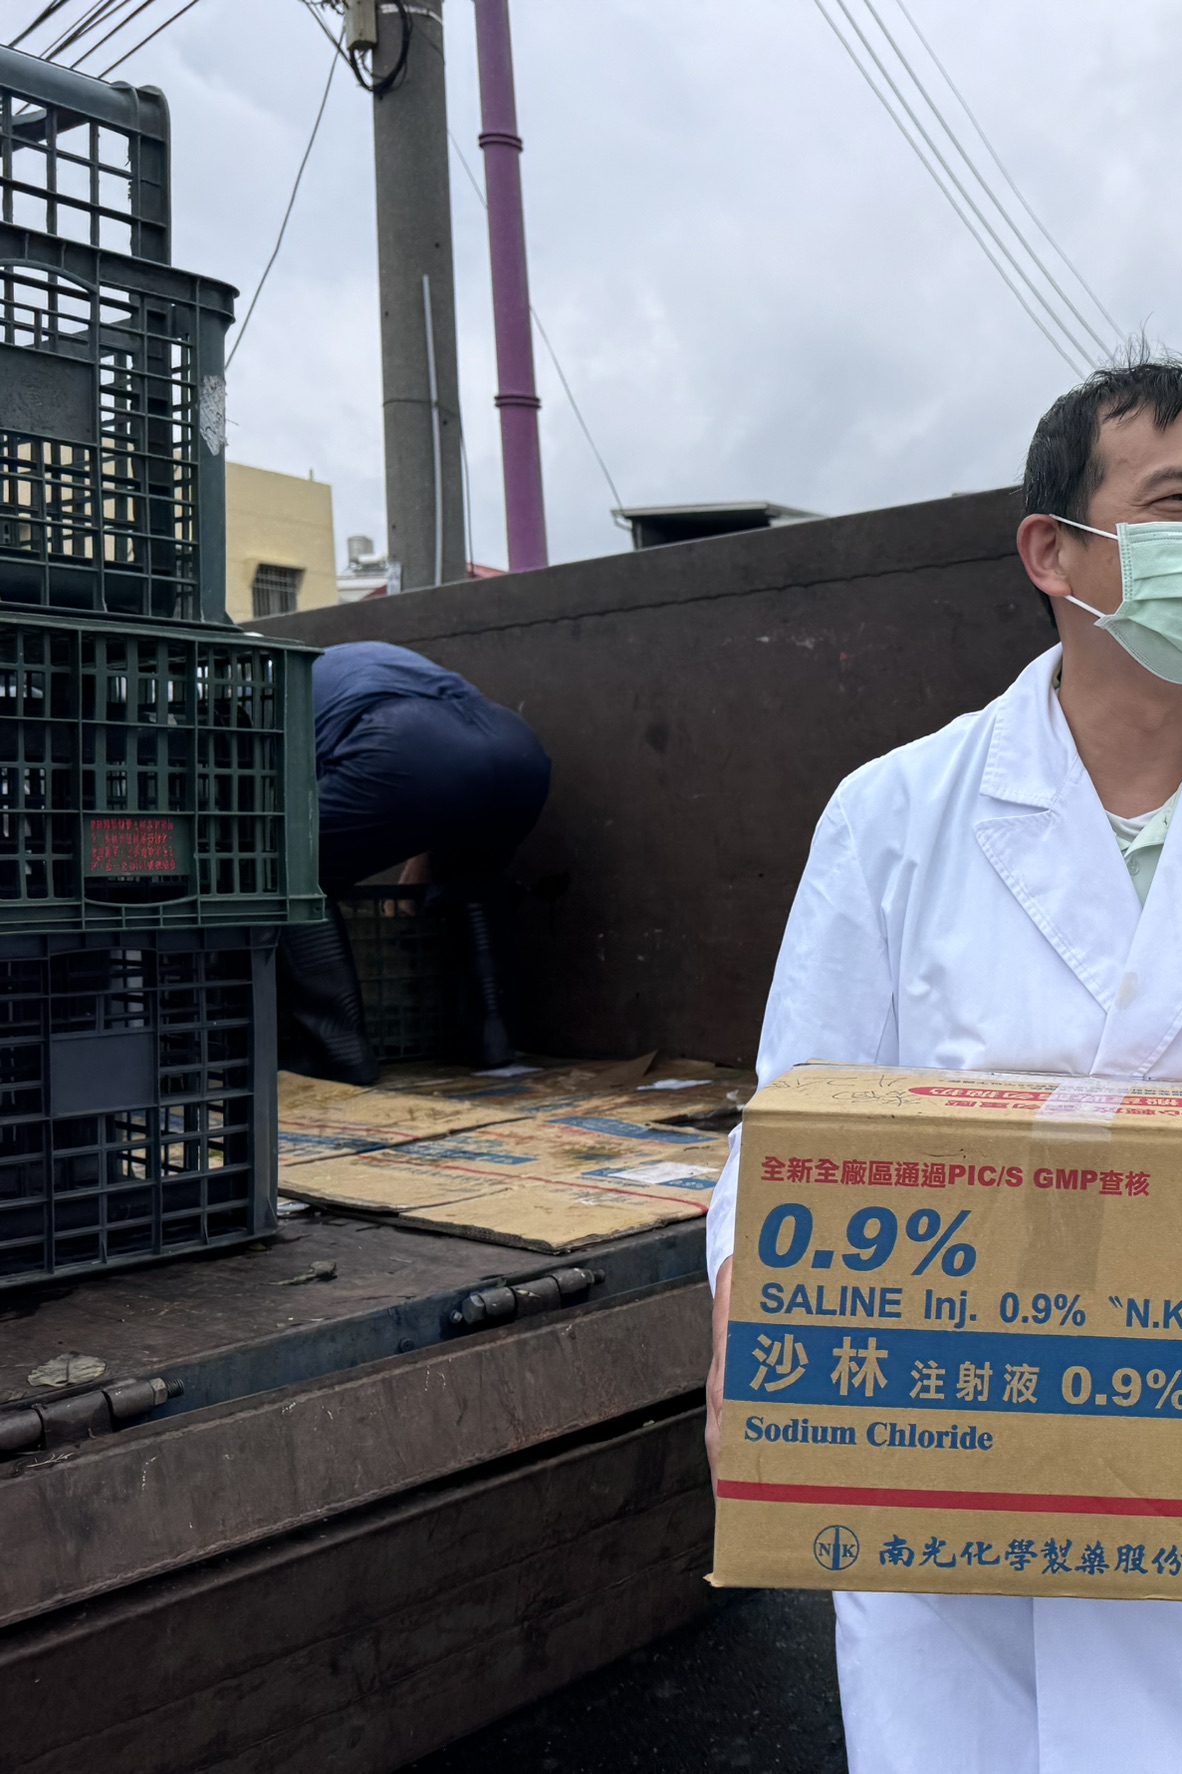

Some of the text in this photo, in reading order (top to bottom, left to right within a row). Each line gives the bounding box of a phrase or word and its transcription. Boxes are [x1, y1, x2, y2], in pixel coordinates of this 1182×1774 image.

[1033, 1168, 1151, 1196] GMP查核
[758, 1202, 977, 1277] 0.9%
[760, 1282, 902, 1319] SALINE
[924, 1289, 976, 1329] Inj.
[999, 1292, 1086, 1327] 0.9%
[909, 1360, 1039, 1405] 注射液
[744, 1415, 993, 1451] Sodium Chloride
